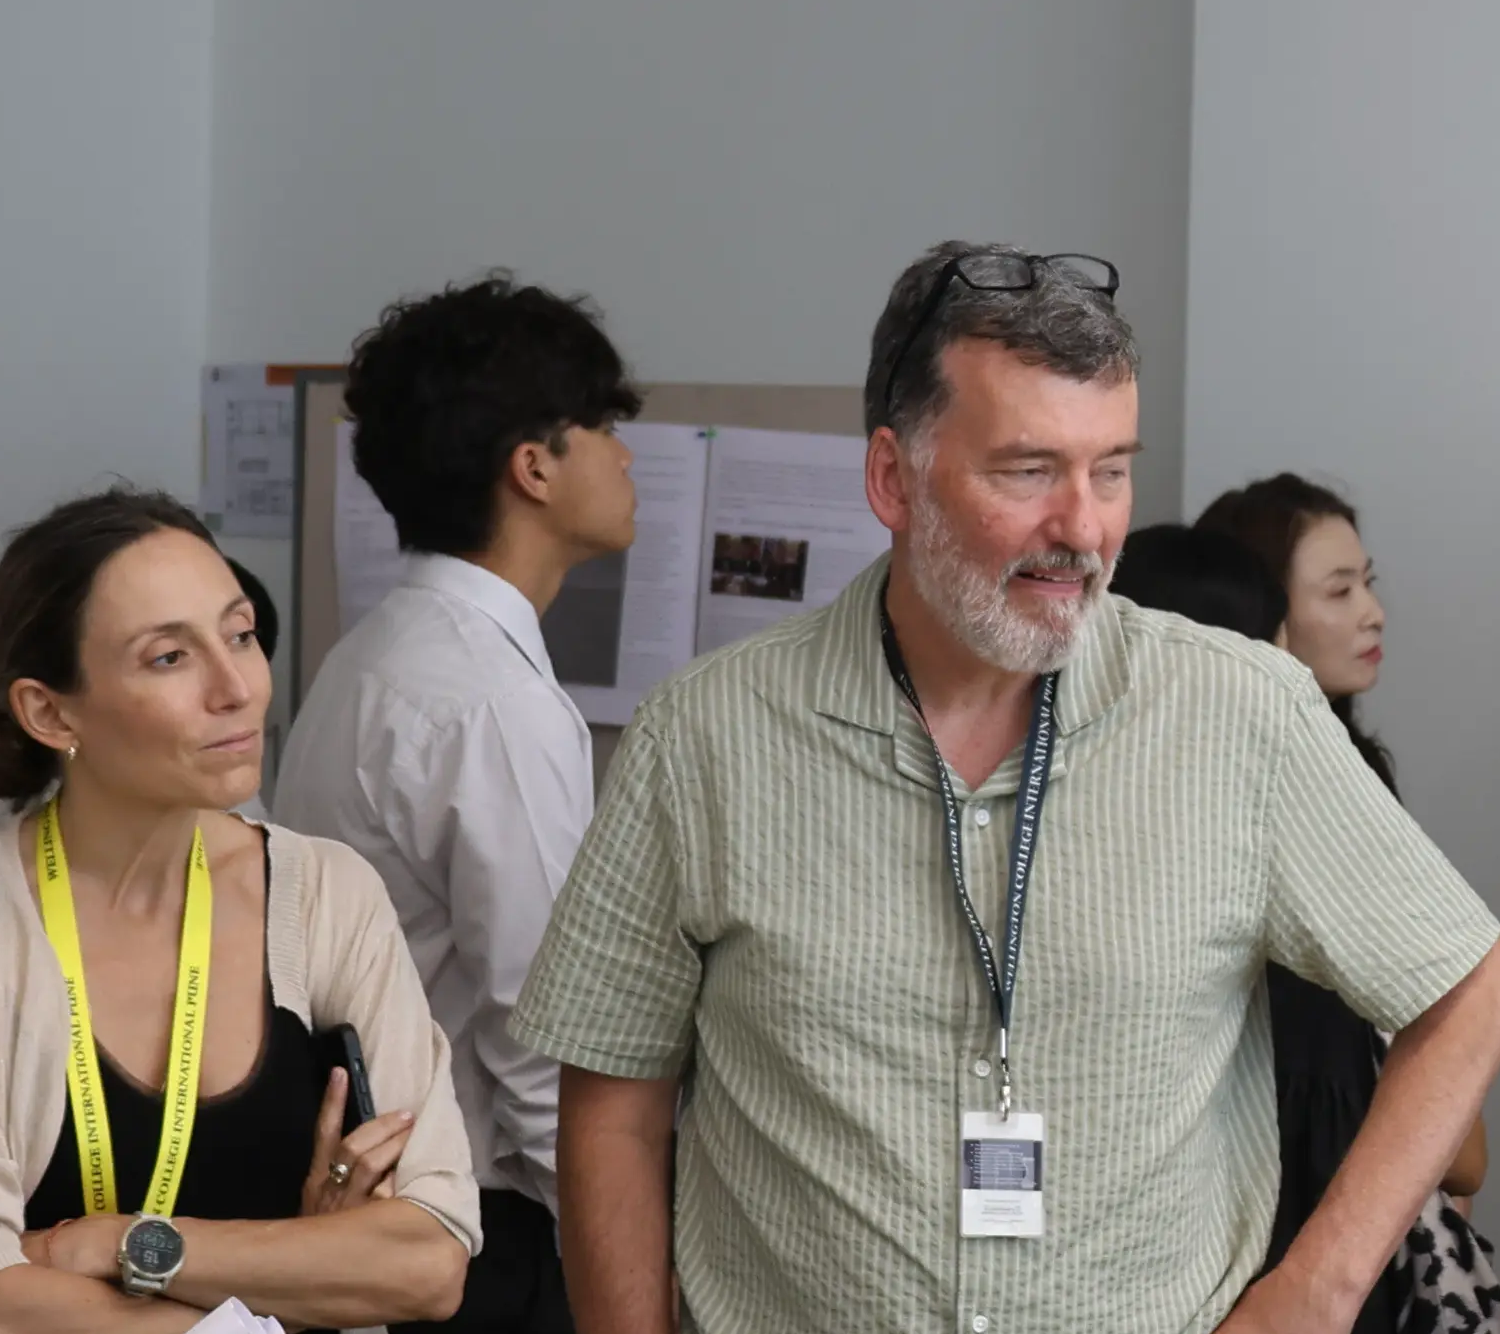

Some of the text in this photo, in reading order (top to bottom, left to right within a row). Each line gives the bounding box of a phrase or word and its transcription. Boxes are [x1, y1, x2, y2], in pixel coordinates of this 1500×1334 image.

[42, 804, 59, 882] WELLING
[950, 830, 966, 895] COLLEGE
[1005, 675, 1055, 992] WELLINGTON COLLEGE INTERNATIONAL PUN
[70, 1020, 100, 1143] INTERNATIONAL
[155, 1135, 183, 1206] COLLEGE
[173, 1010, 197, 1133] INTERNATIONAL
[186, 965, 201, 1007] PUNE
[89, 1146, 106, 1211] COLLEGE
